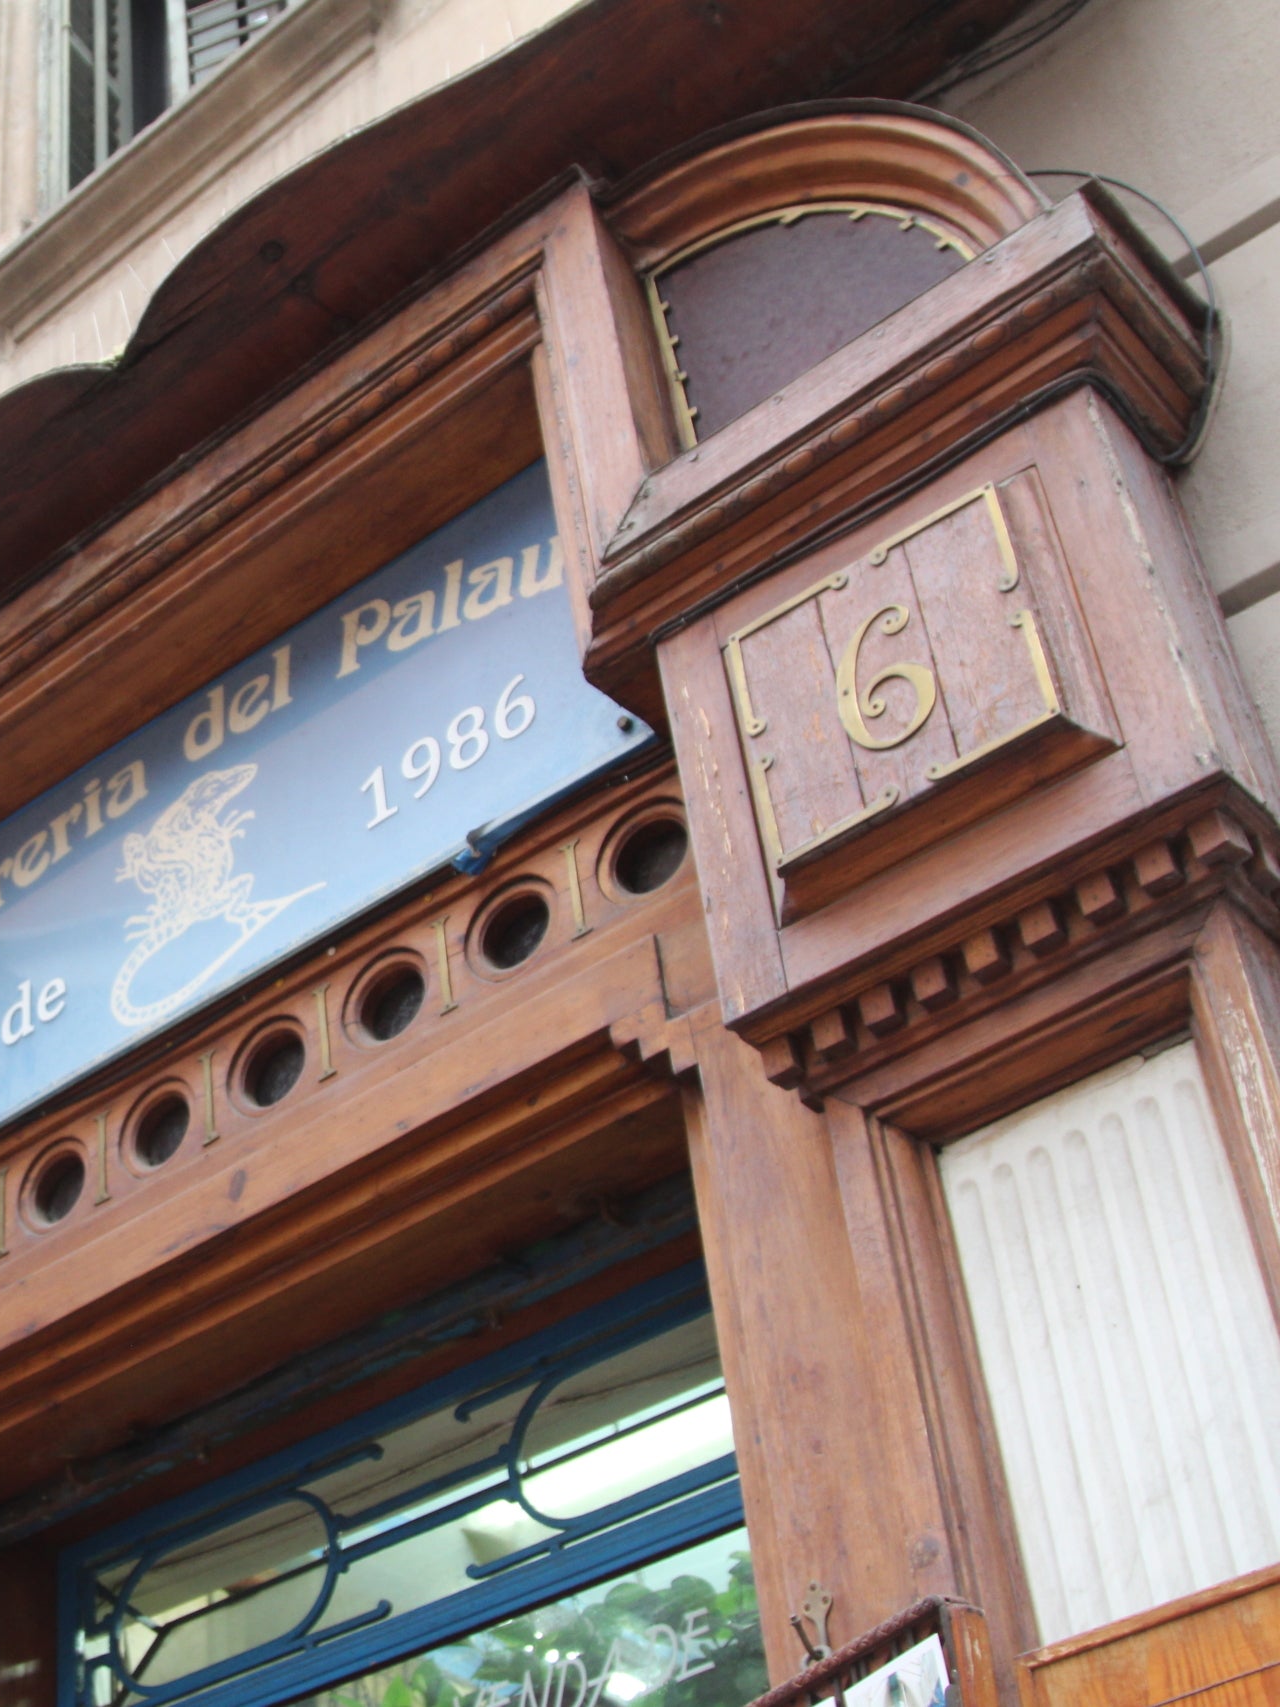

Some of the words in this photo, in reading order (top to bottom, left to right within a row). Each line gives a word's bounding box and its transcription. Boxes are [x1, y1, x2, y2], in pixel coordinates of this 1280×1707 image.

[183, 644, 293, 762] del
[335, 534, 564, 679] Palau
[835, 604, 937, 751] 6
[0, 976, 67, 1046] de
[360, 673, 537, 829] 1986
